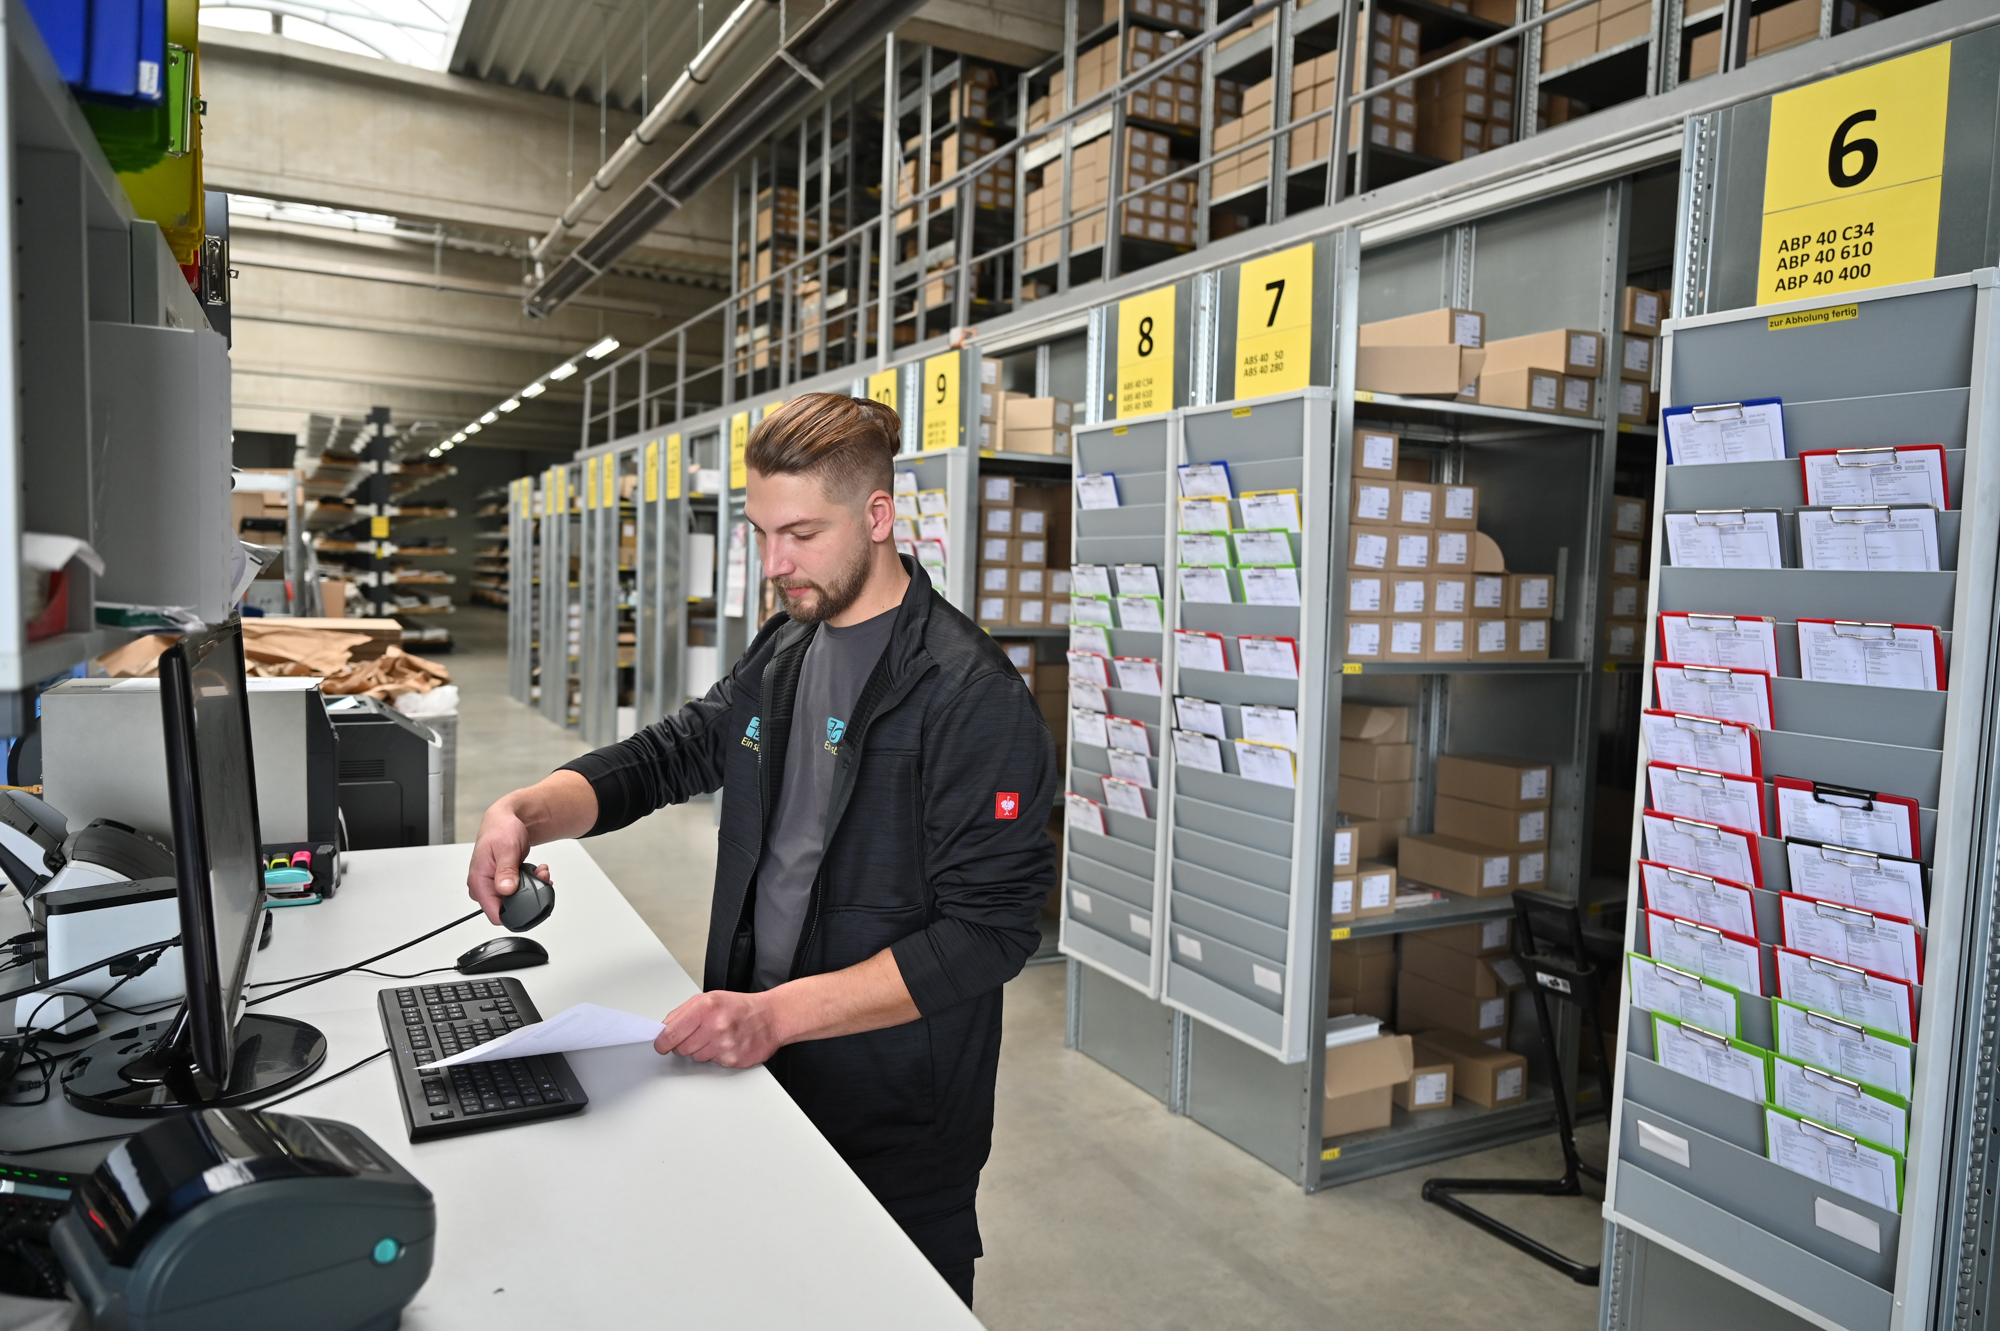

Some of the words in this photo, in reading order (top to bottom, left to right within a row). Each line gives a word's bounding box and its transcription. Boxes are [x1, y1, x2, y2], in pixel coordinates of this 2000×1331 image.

[1828, 108, 1879, 189] 6
[1778, 235, 1812, 254] ABP
[1816, 229, 1837, 245] 40
[1842, 222, 1875, 241] C34
[1776, 253, 1810, 272] ABP
[1815, 248, 1836, 264] 40
[1840, 241, 1873, 260] 610
[1775, 274, 1809, 293] ABP
[1813, 269, 1834, 285] 40
[1838, 263, 1871, 281] 400
[1265, 279, 1286, 328] 7
[1769, 319, 1784, 328] zur
[1785, 312, 1830, 326] Abholung
[1832, 308, 1857, 318] fertig
[1137, 316, 1154, 358] 8
[1243, 366, 1258, 377] ABS
[1259, 364, 1269, 374] 40
[1244, 355, 1258, 366] ABS
[1260, 353, 1269, 362] 40
[1274, 350, 1284, 361] 50
[937, 373, 947, 405] 9
[741, 737, 753, 749] Ein
